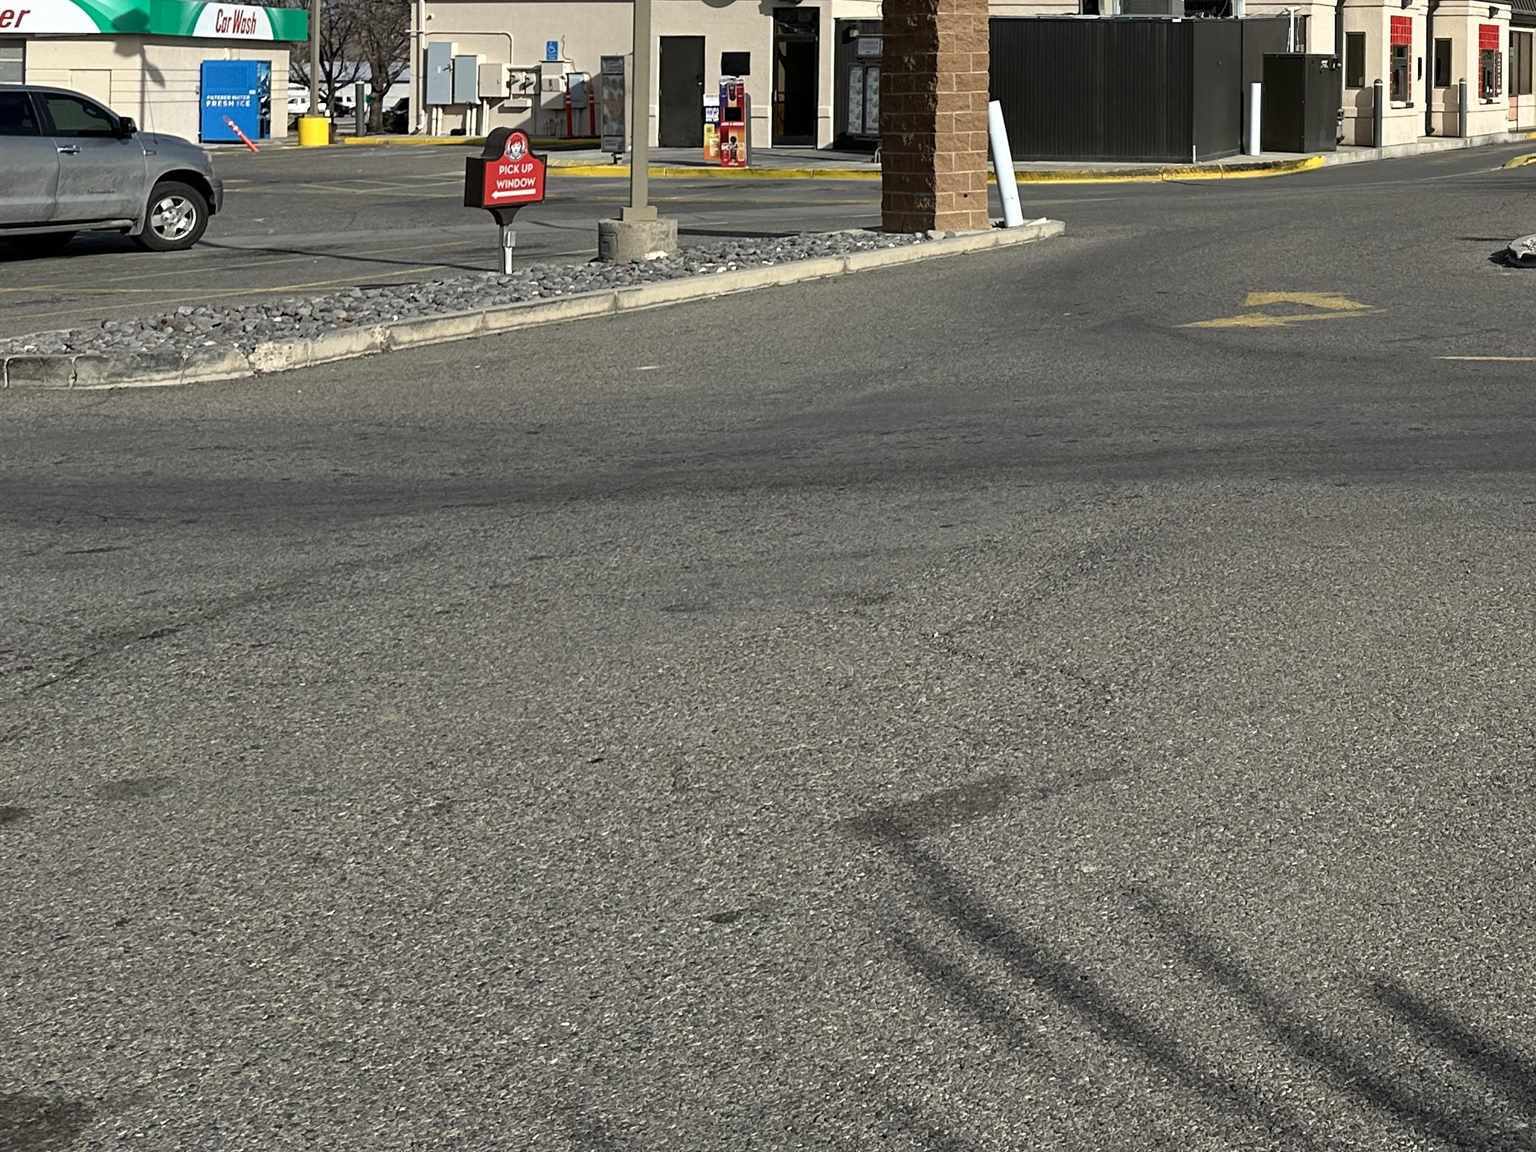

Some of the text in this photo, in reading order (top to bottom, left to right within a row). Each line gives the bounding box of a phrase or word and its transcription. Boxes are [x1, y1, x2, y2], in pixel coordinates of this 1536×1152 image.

[0, 9, 31, 28] er
[215, 8, 257, 35] Car Wash
[498, 163, 534, 175] PICK UP
[496, 177, 536, 189] WINDOW
